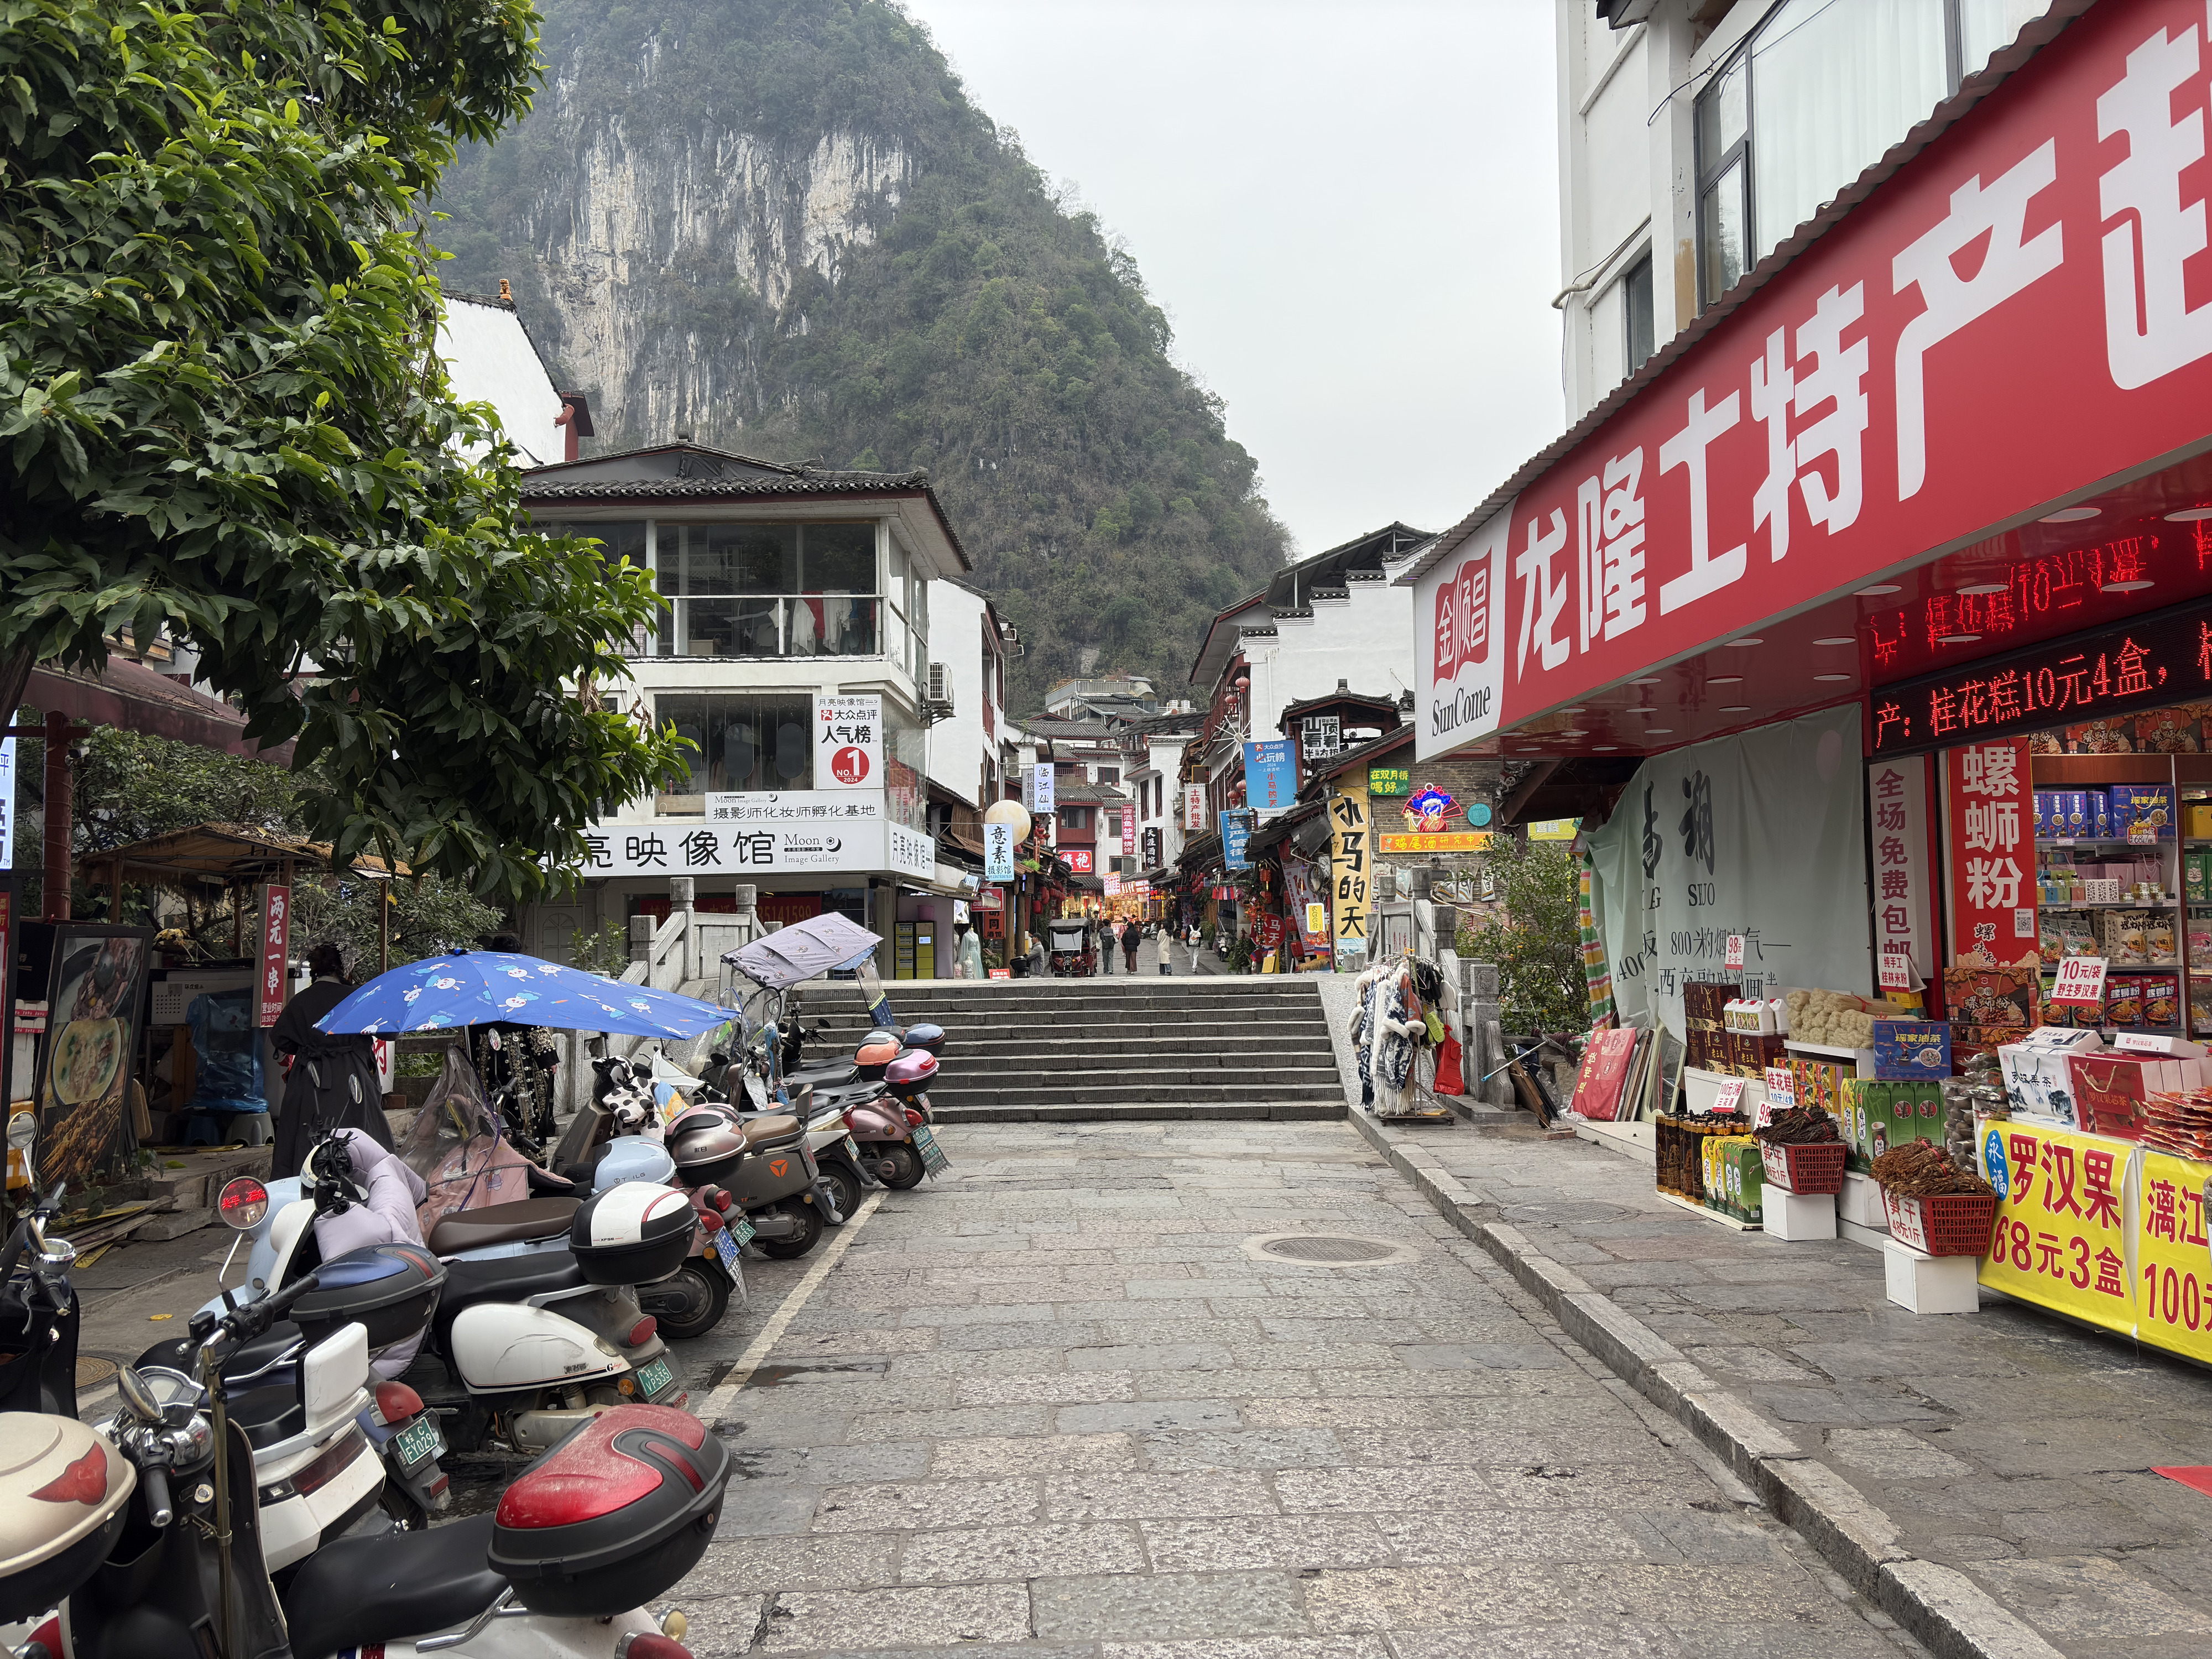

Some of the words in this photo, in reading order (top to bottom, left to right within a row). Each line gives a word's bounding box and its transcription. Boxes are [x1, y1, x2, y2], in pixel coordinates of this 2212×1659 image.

[834, 709, 878, 721] 大众点评
[1432, 686, 1491, 738] SunCome
[821, 725, 872, 744] 人气榜
[1254, 753, 1285, 763] 必玩榜
[1370, 769, 1408, 780] 在双月桥
[1267, 772, 1278, 807] 小马的天
[1370, 781, 1397, 794] 喝好
[1395, 785, 1408, 794] drink
[714, 796, 737, 804] Moon
[1190, 789, 1201, 828] 土特产批发
[2131, 796, 2168, 805] 瑶家油茶
[713, 805, 877, 820] 摄影师化妆师孵化基地
[1123, 808, 1134, 854] 啤酒鱼炒菜烧烤
[1962, 745, 2024, 910] 螺蛳粉
[784, 833, 820, 846] Moon
[990, 826, 1008, 864] 意素
[1147, 829, 1156, 865] 天涯酒馆
[1394, 836, 1437, 850] 鸡尾酒
[1439, 834, 1488, 845] 研究中
[553, 830, 776, 868] 亮映像馆
[892, 832, 926, 869] 月亮映像馆
[784, 855, 808, 865] Image
[810, 855, 839, 864] Gallery
[1332, 795, 1366, 938] 小马的天
[988, 865, 1011, 875] 摄影馆
[268, 895, 285, 995] 两元一串
[1728, 936, 1742, 954] 98元
[1884, 956, 1903, 968] 纯手工
[2061, 961, 2102, 980] 10元/袋
[1881, 971, 1907, 984] 桂林米粉
[2056, 983, 2099, 999] 野生罗汉果
[262, 1001, 283, 1014] 营业时间
[1895, 1033, 1942, 1043] 瑶家油茶
[1767, 1071, 1793, 1094] 桂花糕
[2011, 1071, 2052, 1088] 罗汉果茶
[1717, 1097, 1735, 1107] 三花酒
[2088, 1091, 2127, 1107] 罗汉果芯茶
[1988, 1134, 2007, 1196] 永福
[2010, 1133, 2122, 1230] 罗汉果
[738, 1228, 754, 1244] A3533
[1892, 1219, 1921, 1244] 48元1斤
[1992, 1215, 2125, 1298] 68元3盒
[645, 1368, 671, 1392] VP535
[404, 1433, 414, 1444] 桂
[417, 1426, 425, 1436] C
[404, 1432, 433, 1461] FY029
